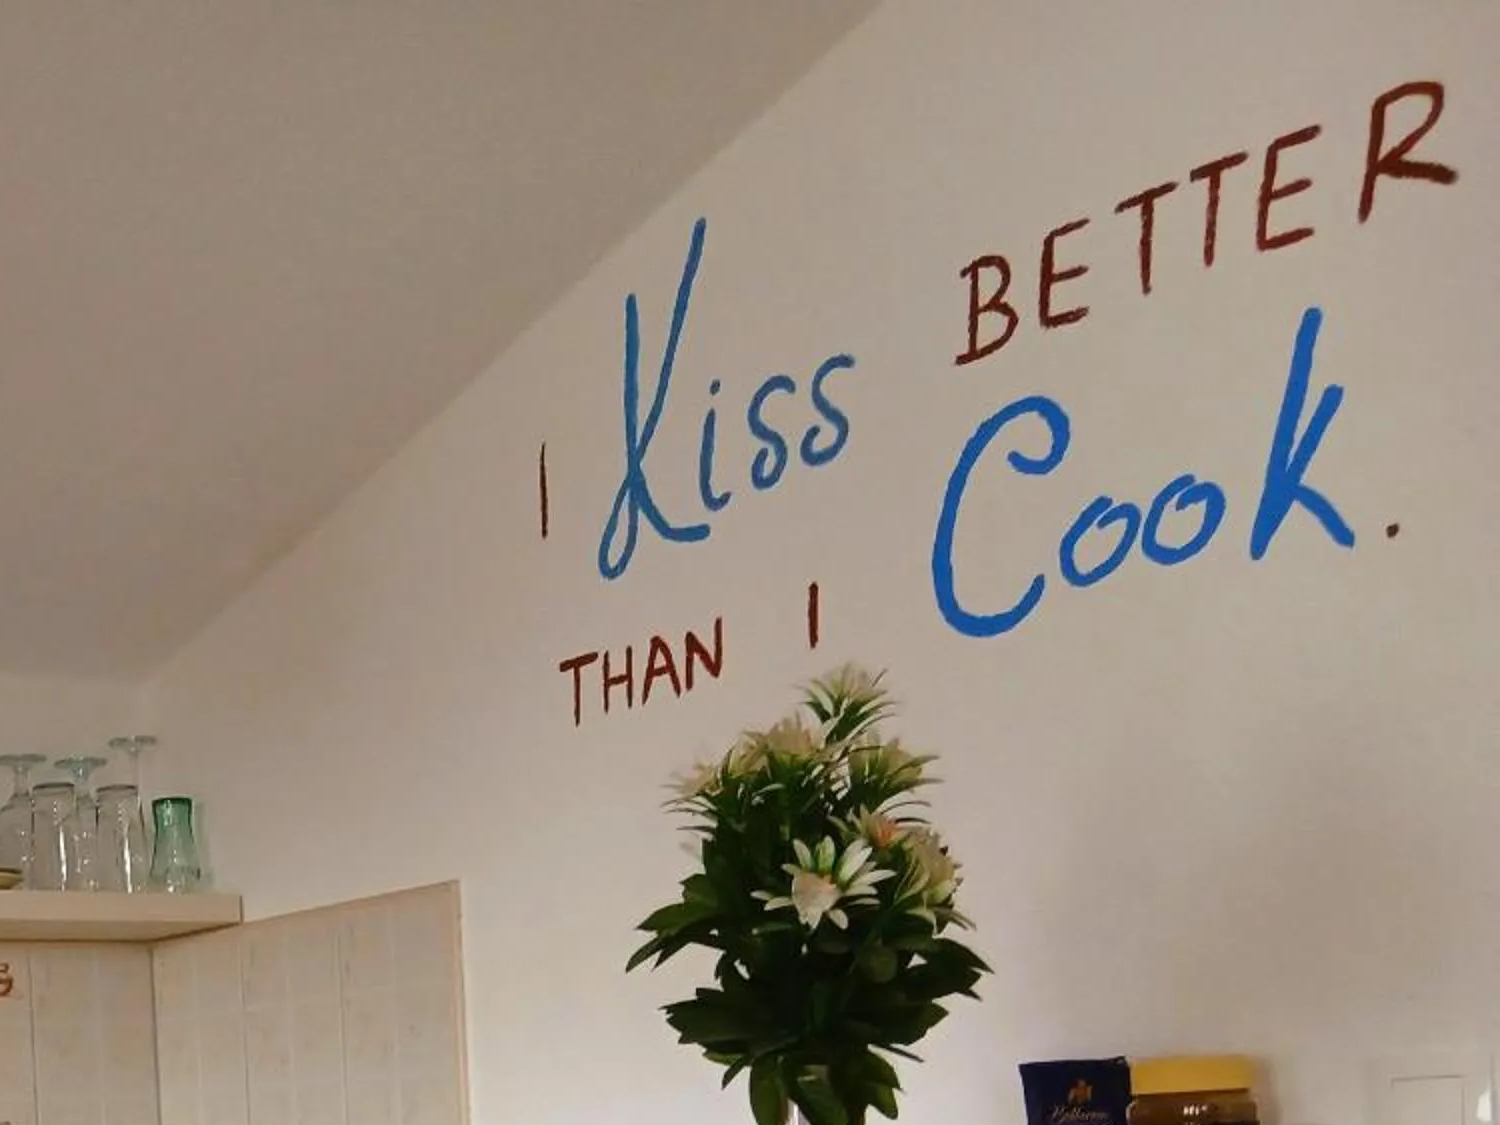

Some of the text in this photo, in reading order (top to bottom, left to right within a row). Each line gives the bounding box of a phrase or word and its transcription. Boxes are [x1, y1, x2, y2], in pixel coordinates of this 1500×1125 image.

[538, 80, 1459, 579] I Kiss BETTER
[558, 617, 725, 726] THAN
[807, 581, 821, 650] I
